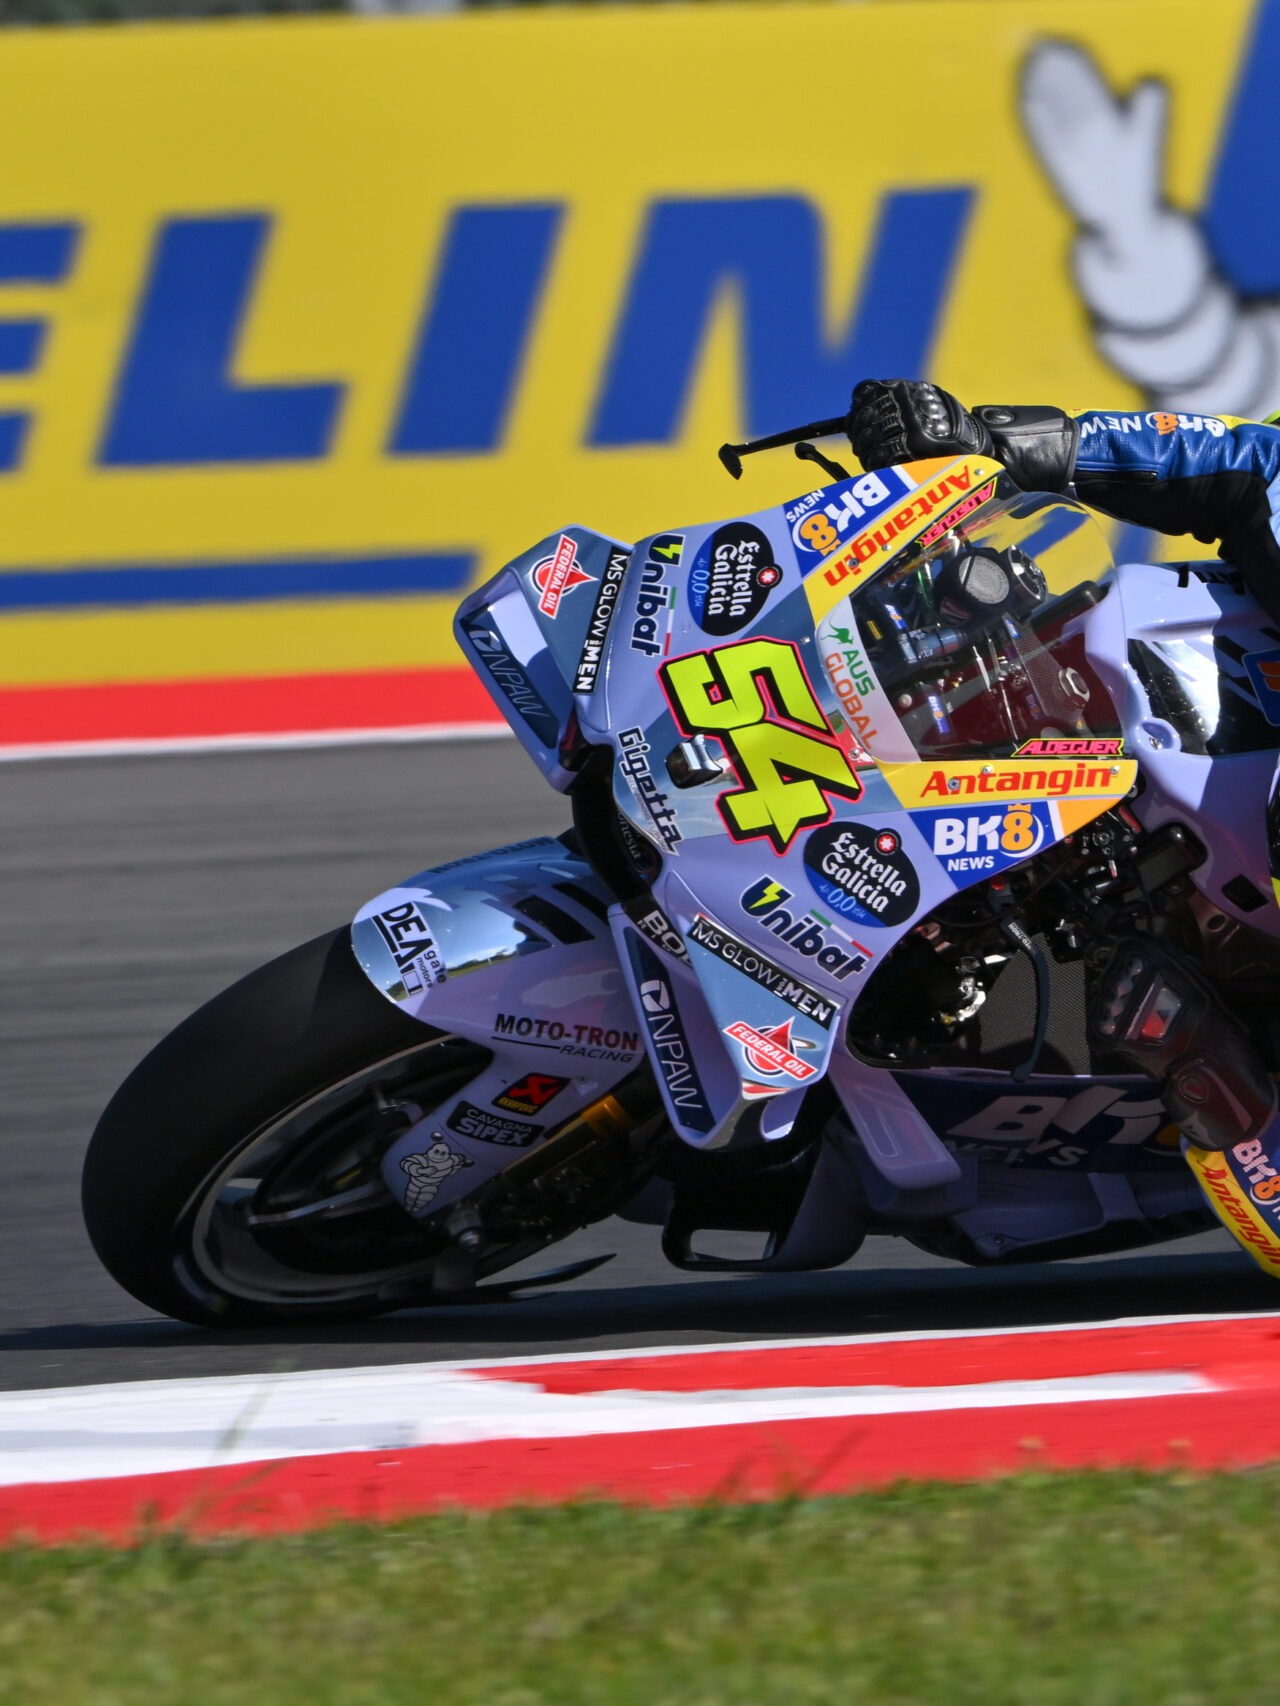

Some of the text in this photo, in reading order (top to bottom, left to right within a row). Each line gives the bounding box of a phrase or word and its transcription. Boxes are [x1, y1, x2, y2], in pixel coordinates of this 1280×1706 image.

[786, 471, 891, 556] BK8 NEWS
[824, 465, 974, 587] Antangin
[921, 481, 995, 547] ALDEGUER
[543, 541, 575, 617] FEDERAL OIL
[606, 553, 629, 585] MS
[691, 569, 710, 599] 0,0
[708, 544, 738, 615] Galicia
[729, 540, 760, 617] Estrella
[594, 585, 620, 640] GLOW
[576, 644, 600, 690] MEN
[844, 650, 876, 697] AUS
[825, 653, 881, 750] GLOBAL
[657, 637, 864, 857] 54
[1018, 740, 1122, 756] ALDEGUER
[618, 727, 683, 853] Gigetta
[920, 763, 1112, 797] Antangin
[934, 803, 1044, 858] BK8
[822, 851, 889, 913] Galicia
[831, 832, 907, 897] Estrella
[948, 856, 994, 872] NEWS
[827, 886, 856, 912] 0,0
[381, 902, 447, 983] DEA gate
[740, 874, 873, 980] Unibat
[417, 958, 433, 988] motors
[693, 921, 719, 949] MS
[722, 942, 779, 986] GLOW
[785, 982, 830, 1021] MEN
[494, 1013, 638, 1051] MOTO-TRON
[560, 1044, 634, 1063] RACING
[733, 1025, 807, 1077] FEDERAL OIL
[456, 1117, 528, 1144] SIPEX
[466, 1109, 532, 1133] CAVAGNA
